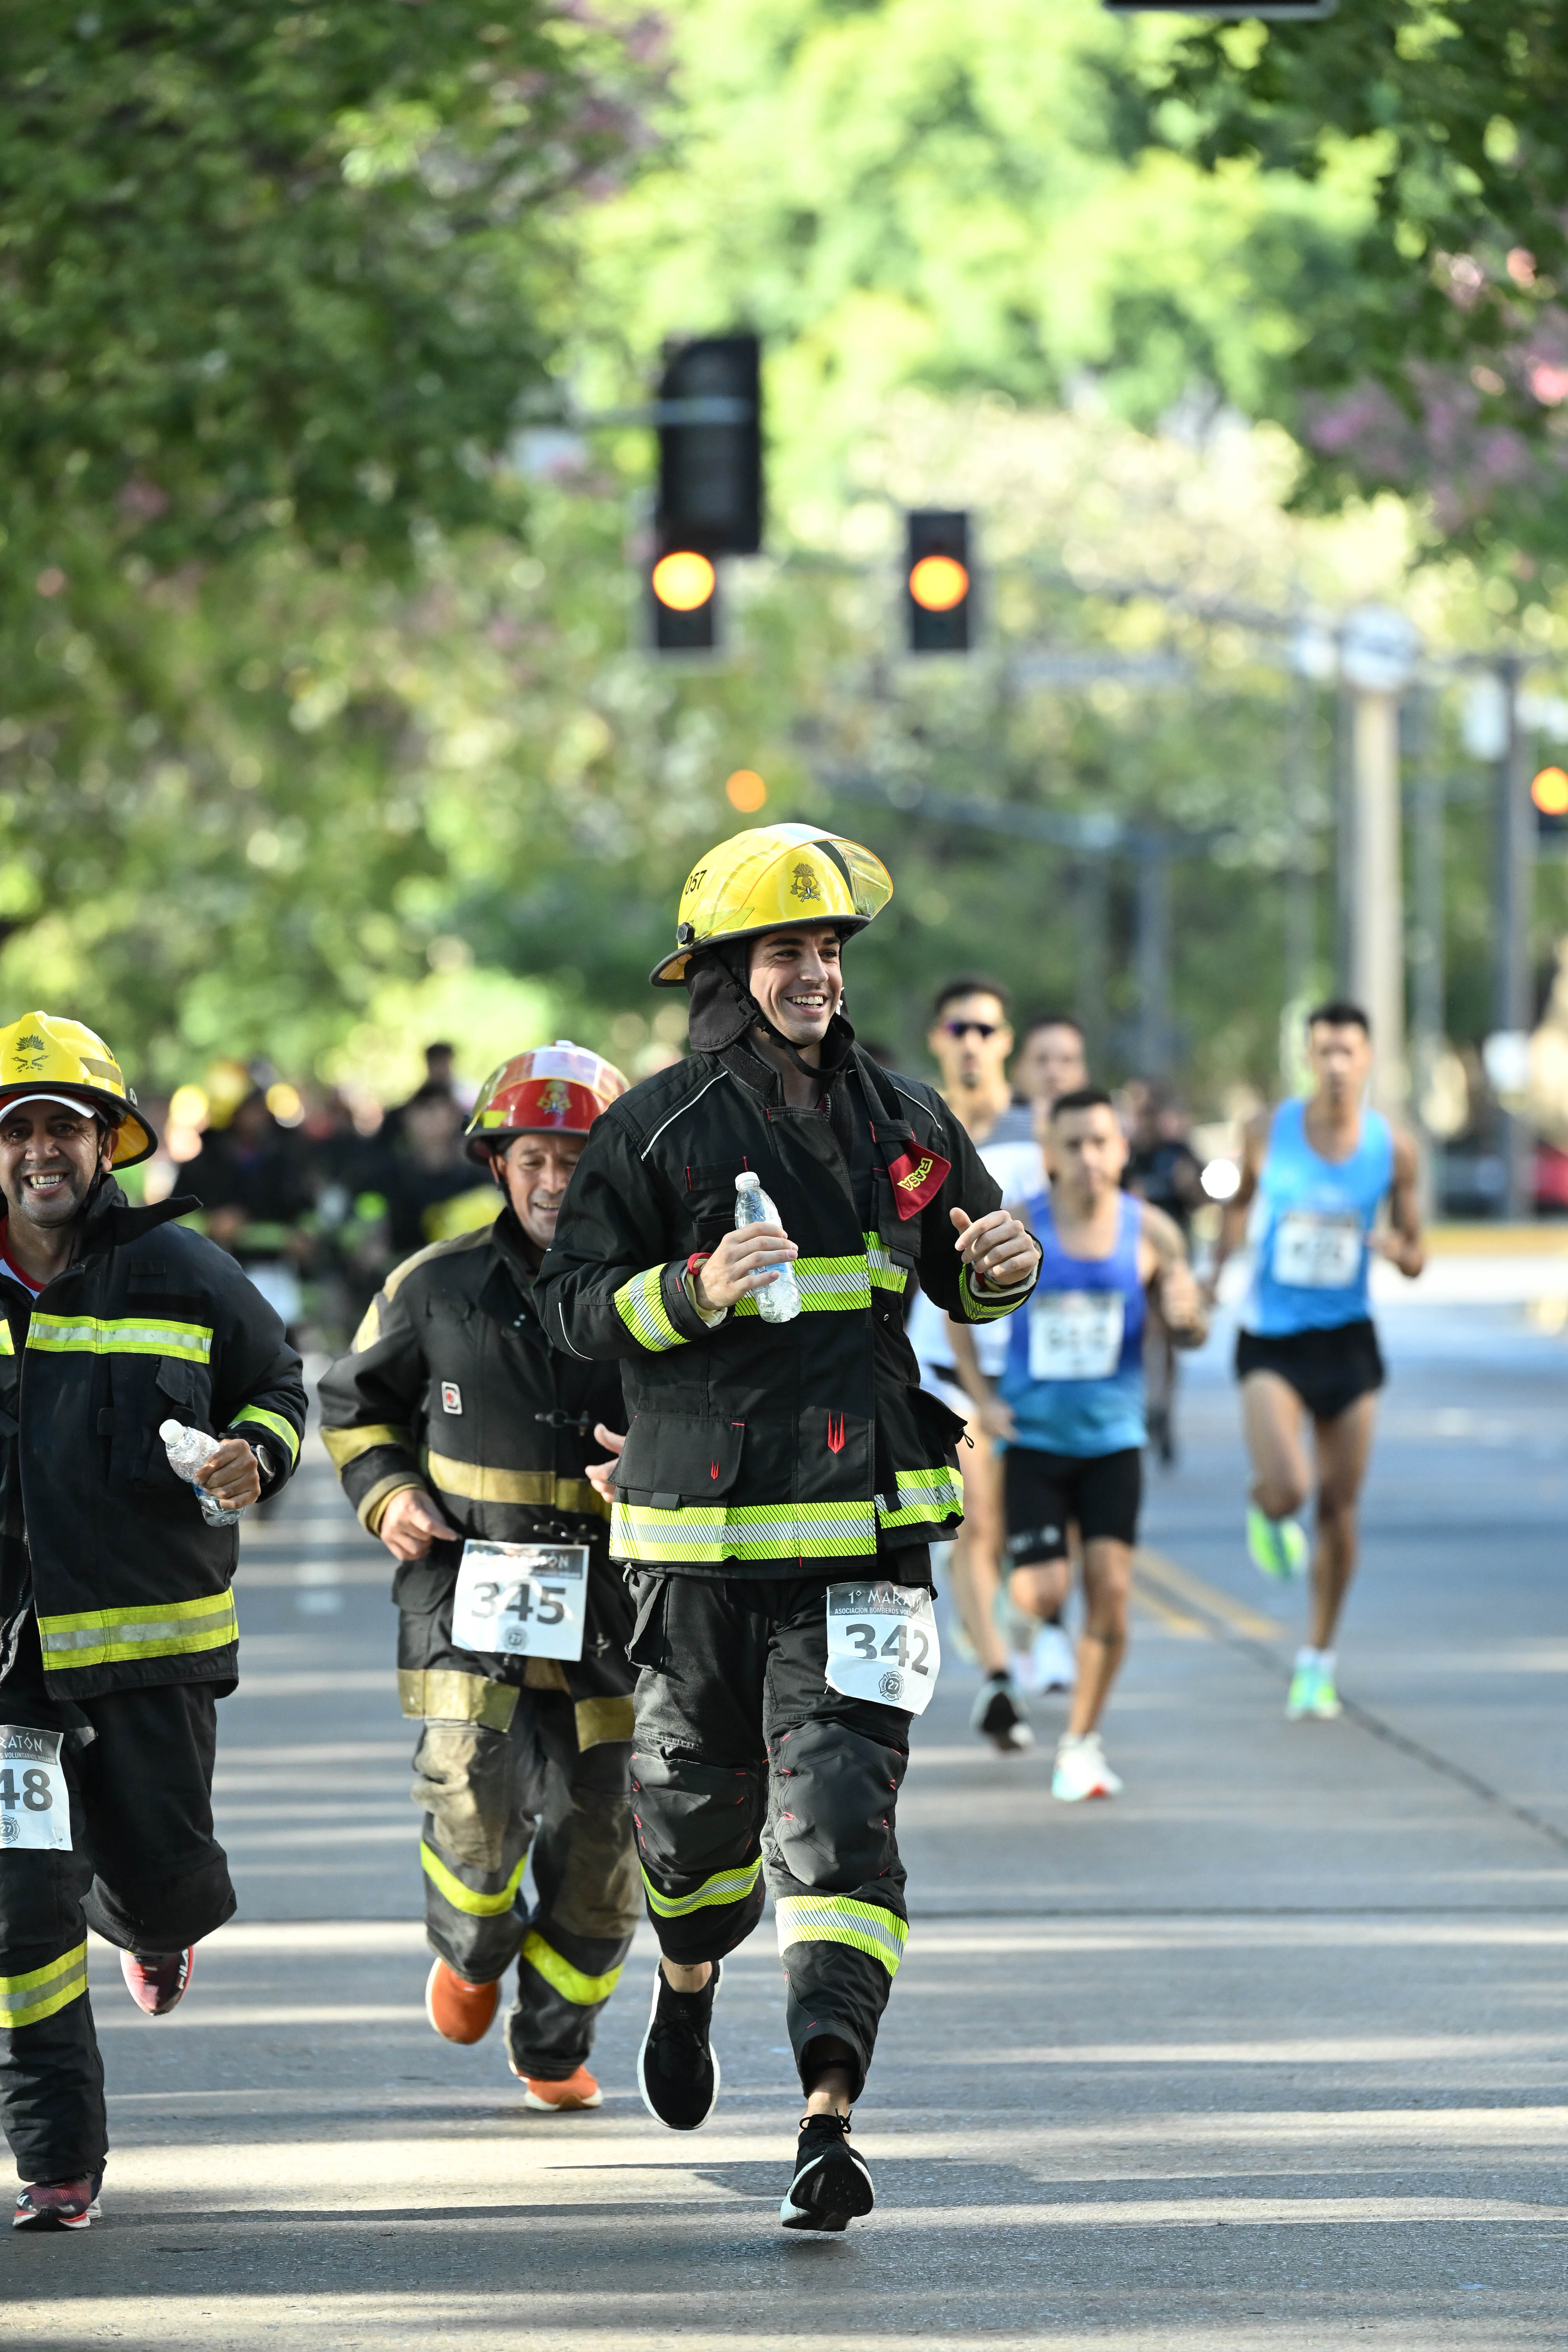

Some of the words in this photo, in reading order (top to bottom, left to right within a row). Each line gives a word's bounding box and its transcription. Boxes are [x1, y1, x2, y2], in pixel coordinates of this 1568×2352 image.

[685, 870, 707, 896] 057
[898, 1157, 933, 1191] RASA
[471, 1582, 566, 1625] 345
[835, 1606, 868, 1615] ASOCIACIÓN
[846, 1623, 929, 1676] 342
[887, 1679, 900, 1690] 27
[5, 1752, 38, 1760] VOLUNTARIOS
[38, 1755, 56, 1764] ROSARIO
[0, 1824, 11, 1834] 27
